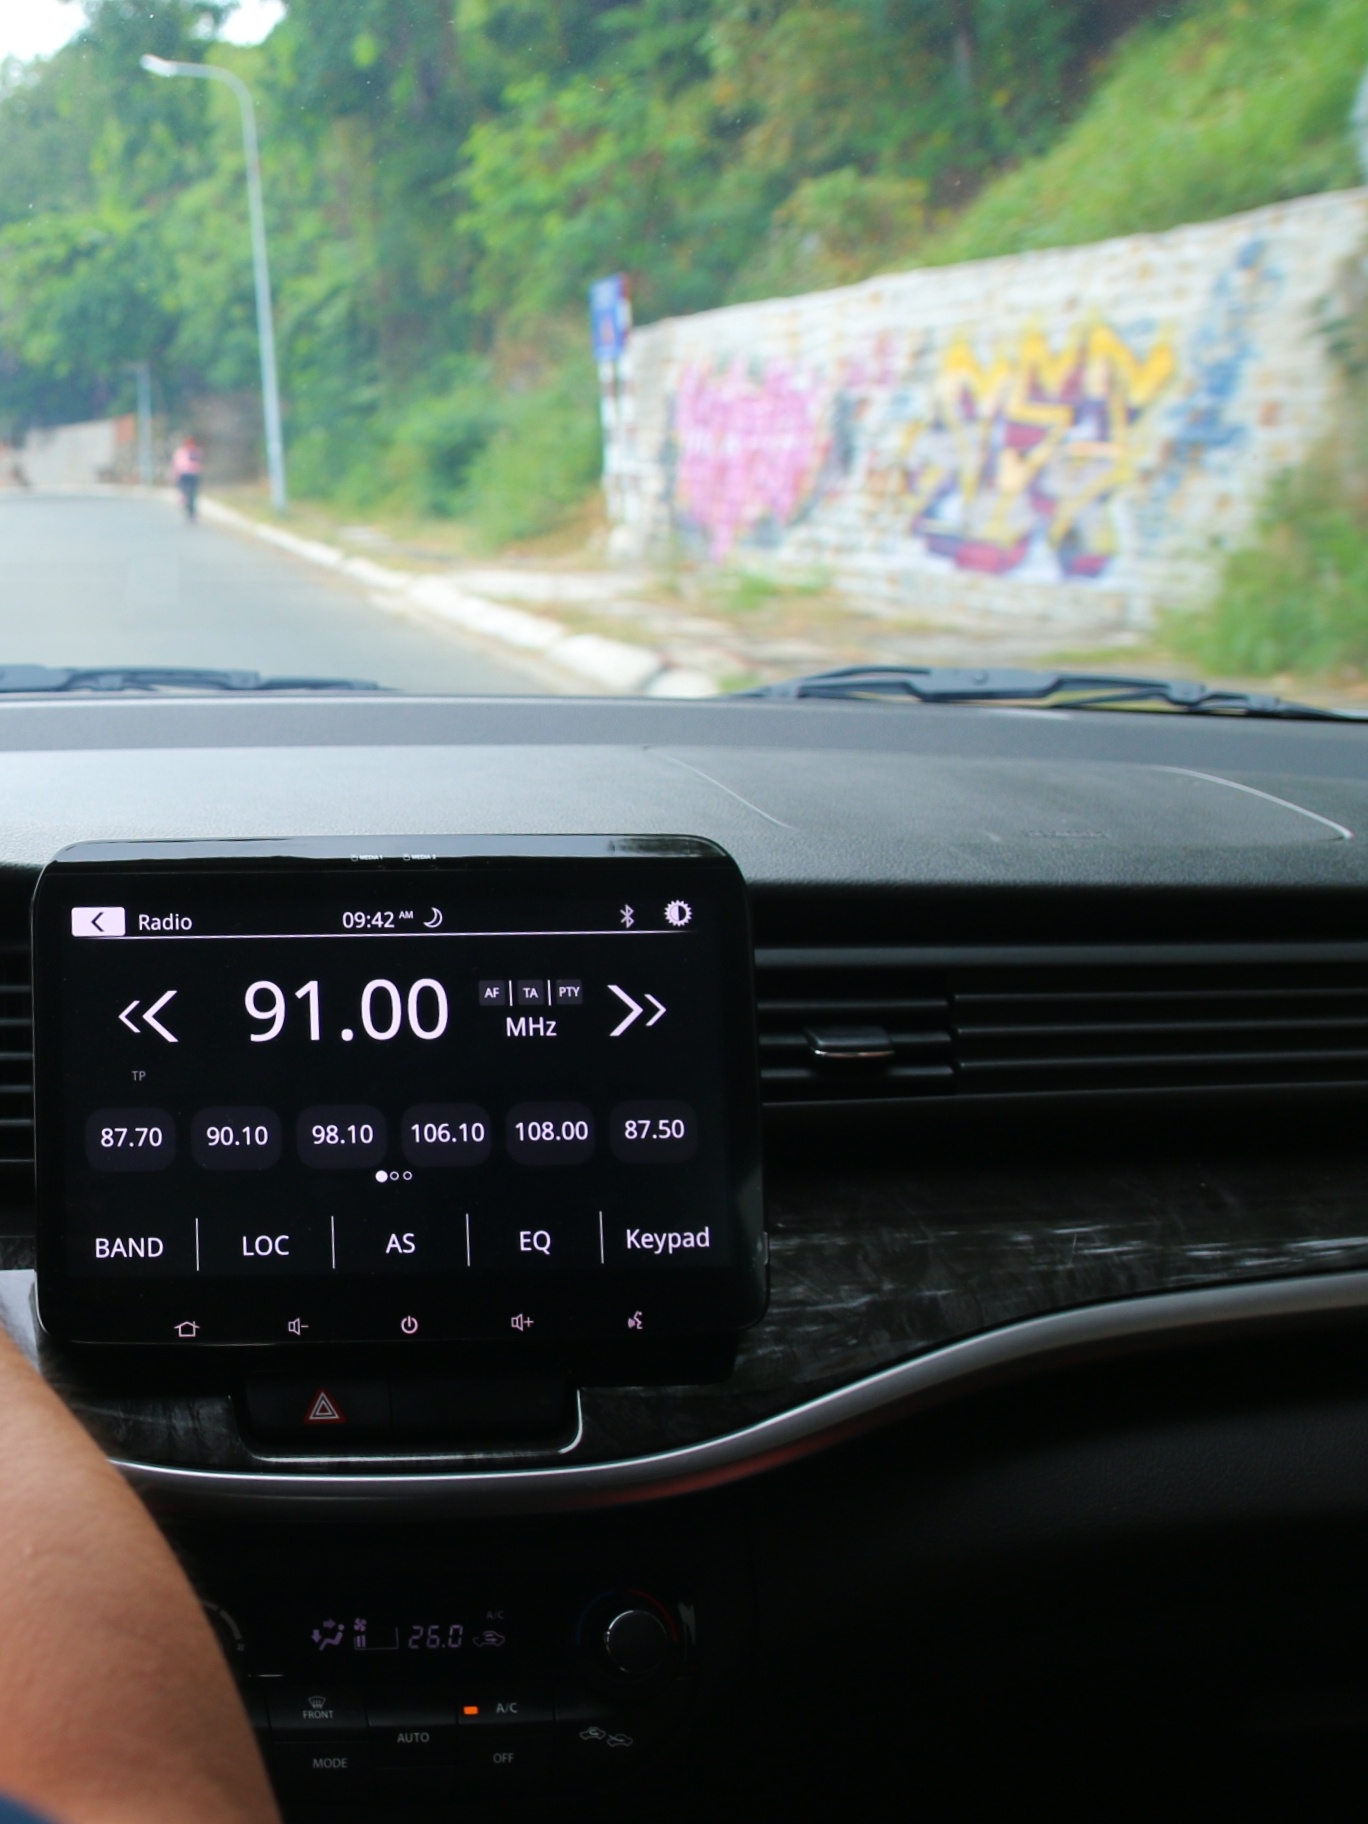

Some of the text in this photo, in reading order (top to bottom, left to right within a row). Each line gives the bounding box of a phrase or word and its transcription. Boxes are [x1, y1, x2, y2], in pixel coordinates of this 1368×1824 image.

[138, 912, 193, 931] Radio
[342, 910, 414, 929] 09:42 AM
[484, 987, 500, 999] AF
[523, 987, 539, 999] TA
[558, 986, 580, 998] PTY
[244, 978, 449, 1043] 91.00
[506, 1016, 558, 1037] MHz
[131, 1070, 147, 1081] TP
[100, 1126, 163, 1148] 87.70
[206, 1125, 269, 1146] 90.10
[311, 1124, 374, 1145] 98.10
[411, 1122, 485, 1143] 106.10
[515, 1120, 589, 1142] 108.00
[624, 1119, 685, 1140] 87.50
[95, 1237, 164, 1259] BAND
[242, 1234, 290, 1257] LOC
[385, 1232, 416, 1254] AS
[519, 1230, 551, 1255] EQ
[626, 1226, 710, 1255] Keypad
[486, 1610, 504, 1620] A/C
[408, 1624, 464, 1650] 26.0
[302, 1709, 334, 1720] FRONT
[495, 1702, 518, 1714] A/C
[396, 1731, 430, 1744] AUTO
[312, 1757, 347, 1769] MODE
[492, 1752, 514, 1764] OFF
